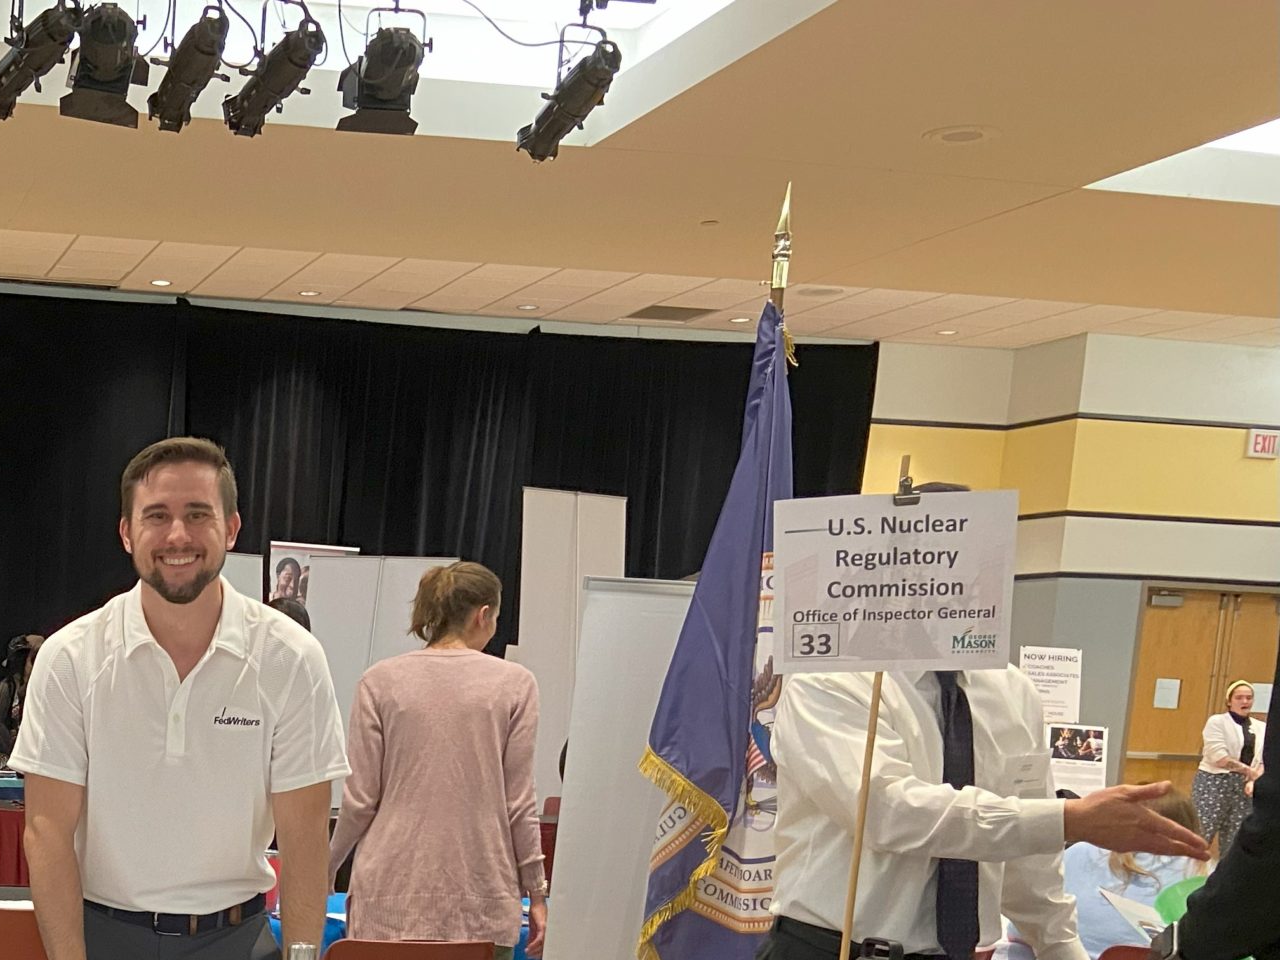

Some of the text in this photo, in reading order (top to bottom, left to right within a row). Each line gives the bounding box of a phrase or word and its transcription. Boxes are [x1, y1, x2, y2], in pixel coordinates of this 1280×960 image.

[1253, 433, 1278, 453] EXIT
[828, 514, 968, 536] U.S. Nuclear
[835, 547, 959, 570] Regulatory
[827, 578, 964, 599] Commission
[793, 605, 996, 623] Office of Inspector General
[799, 633, 832, 656] 33
[952, 635, 996, 649] MASON
[1024, 653, 1079, 663] NOW HIRING
[213, 716, 261, 726] FedWriters
